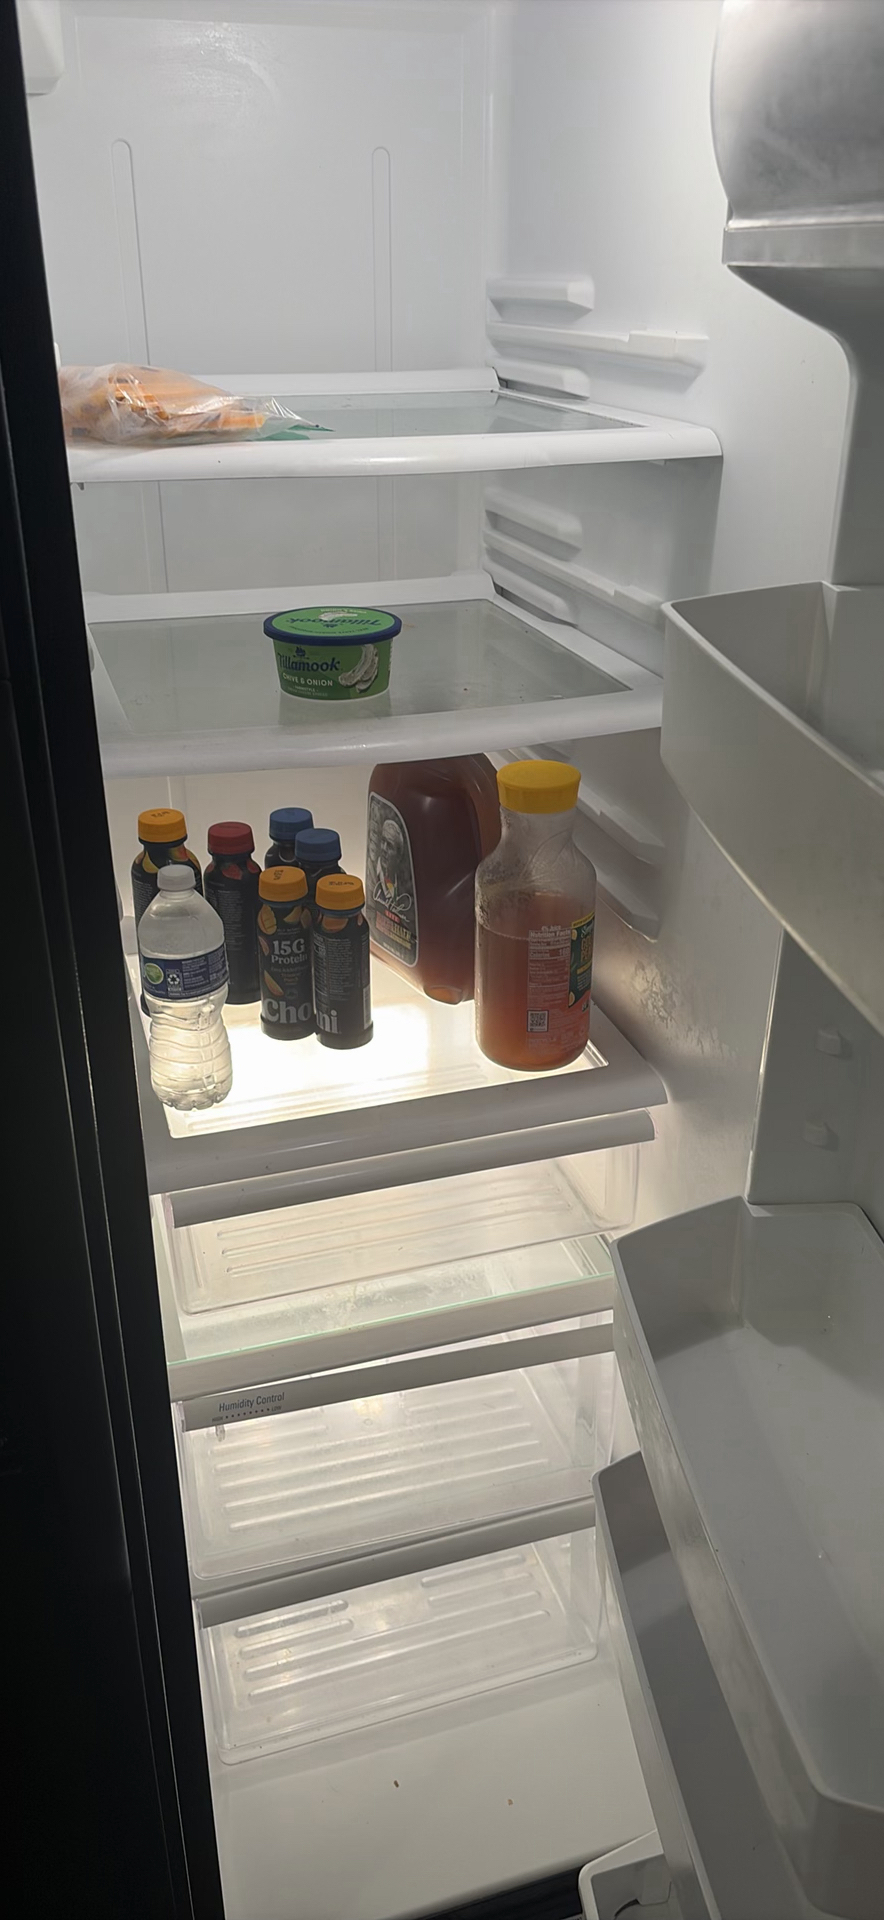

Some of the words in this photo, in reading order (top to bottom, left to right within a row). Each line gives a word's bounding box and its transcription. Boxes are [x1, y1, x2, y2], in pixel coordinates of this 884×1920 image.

[277, 652, 341, 673] Tillamook
[282, 672, 299, 684] CHIVE
[306, 678, 334, 687] ONION
[529, 930, 555, 938] Nutrition
[556, 928, 571, 937] Facts
[272, 938, 306, 956] 15G
[271, 953, 308, 965] Protein
[218, 1397, 255, 1413] Humidity
[255, 1391, 285, 1406] Control
